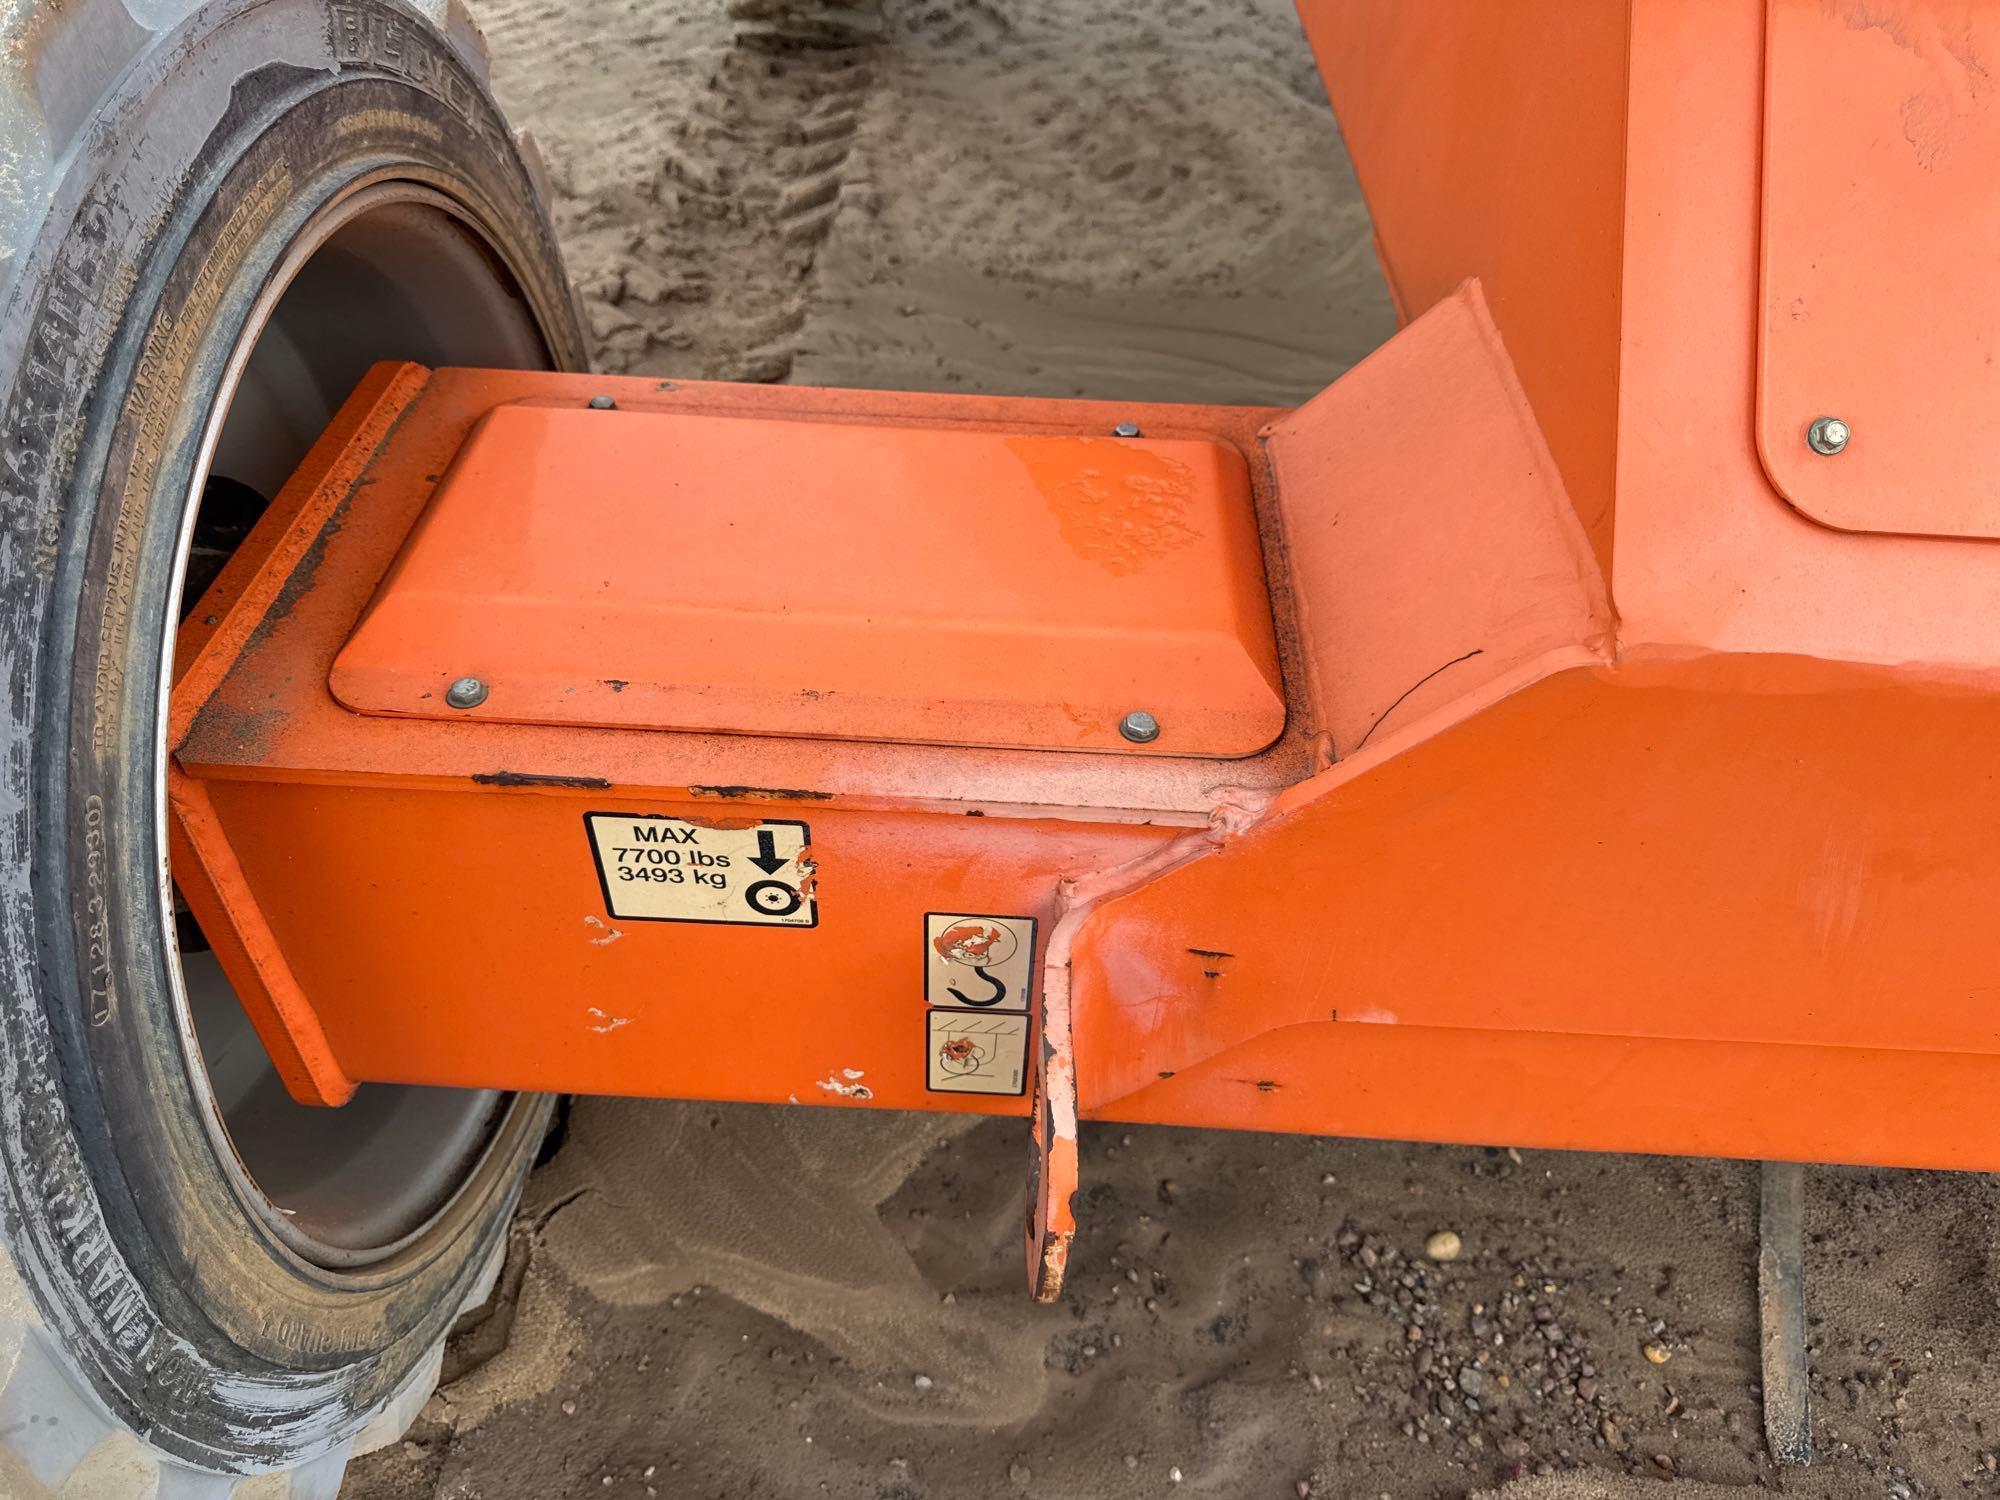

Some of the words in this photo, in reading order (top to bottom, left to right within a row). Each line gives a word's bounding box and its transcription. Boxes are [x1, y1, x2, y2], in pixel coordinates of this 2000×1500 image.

[127, 312, 175, 418] WARNING
[95, 653, 108, 713] AVOID
[93, 725, 103, 750] TO
[633, 826, 699, 844] MAX
[612, 848, 681, 865] 7700
[689, 850, 731, 867] lbs
[617, 866, 685, 884] 3493
[693, 869, 727, 889] kg
